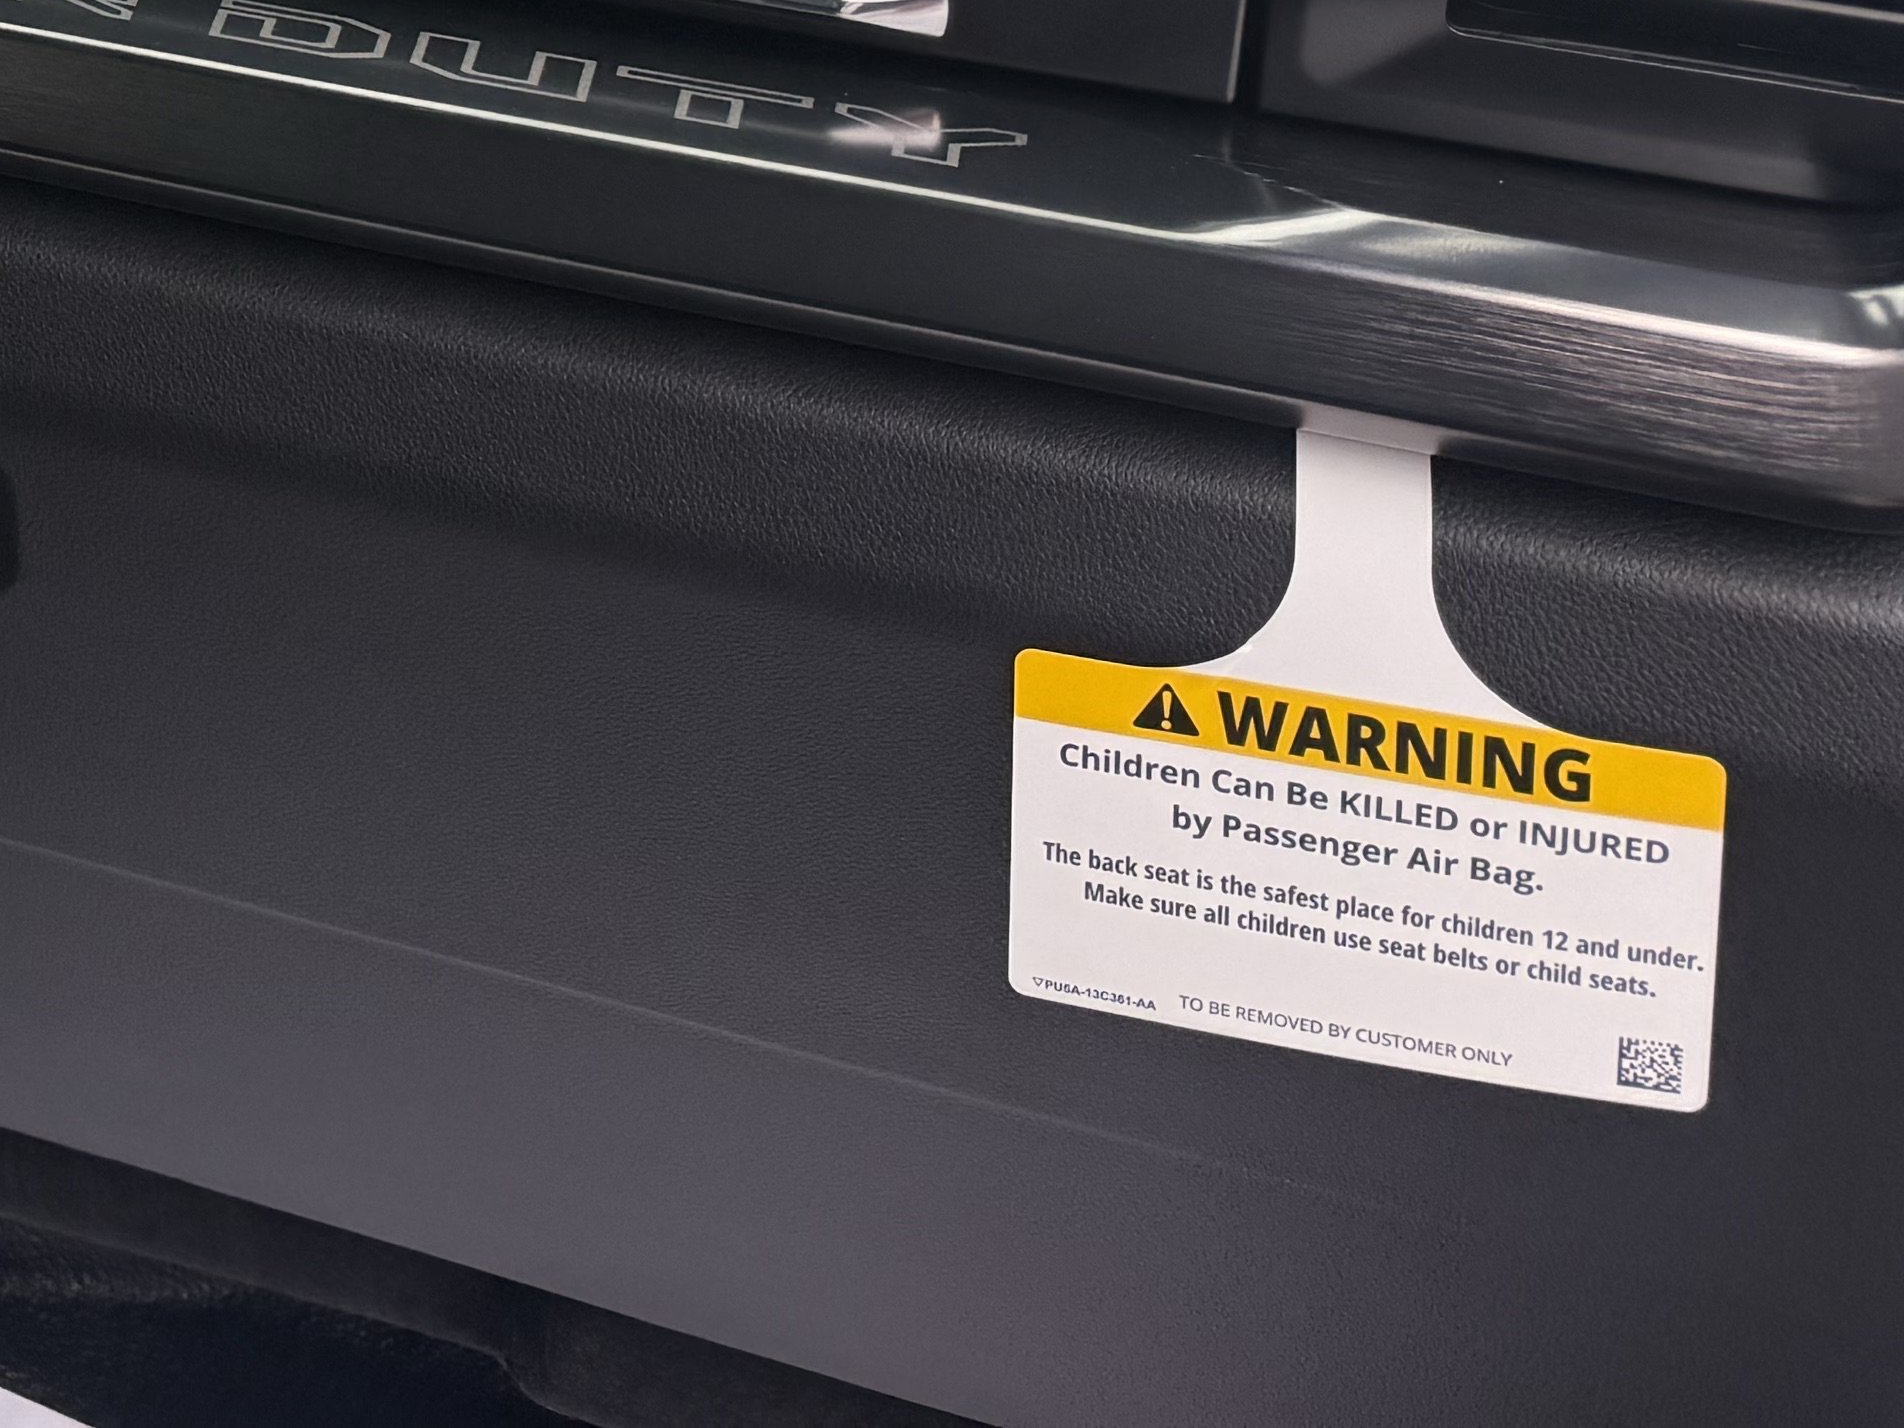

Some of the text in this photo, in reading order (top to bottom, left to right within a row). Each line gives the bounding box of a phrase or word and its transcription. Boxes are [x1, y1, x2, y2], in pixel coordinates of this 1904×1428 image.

[1059, 742, 1671, 865] Children Can Be KILLED or INJURED
[1216, 690, 1592, 803] WARNING
[1042, 841, 1705, 973] The back seat is the safest place for children 12 and under.
[1172, 804, 1544, 895] by Passenger Air Bag.
[1084, 881, 1657, 998] Make sure all children use seat belts or child seats.
[1179, 994, 1514, 1069] TO BE REMOVED BY CUSTOMER ONLY
